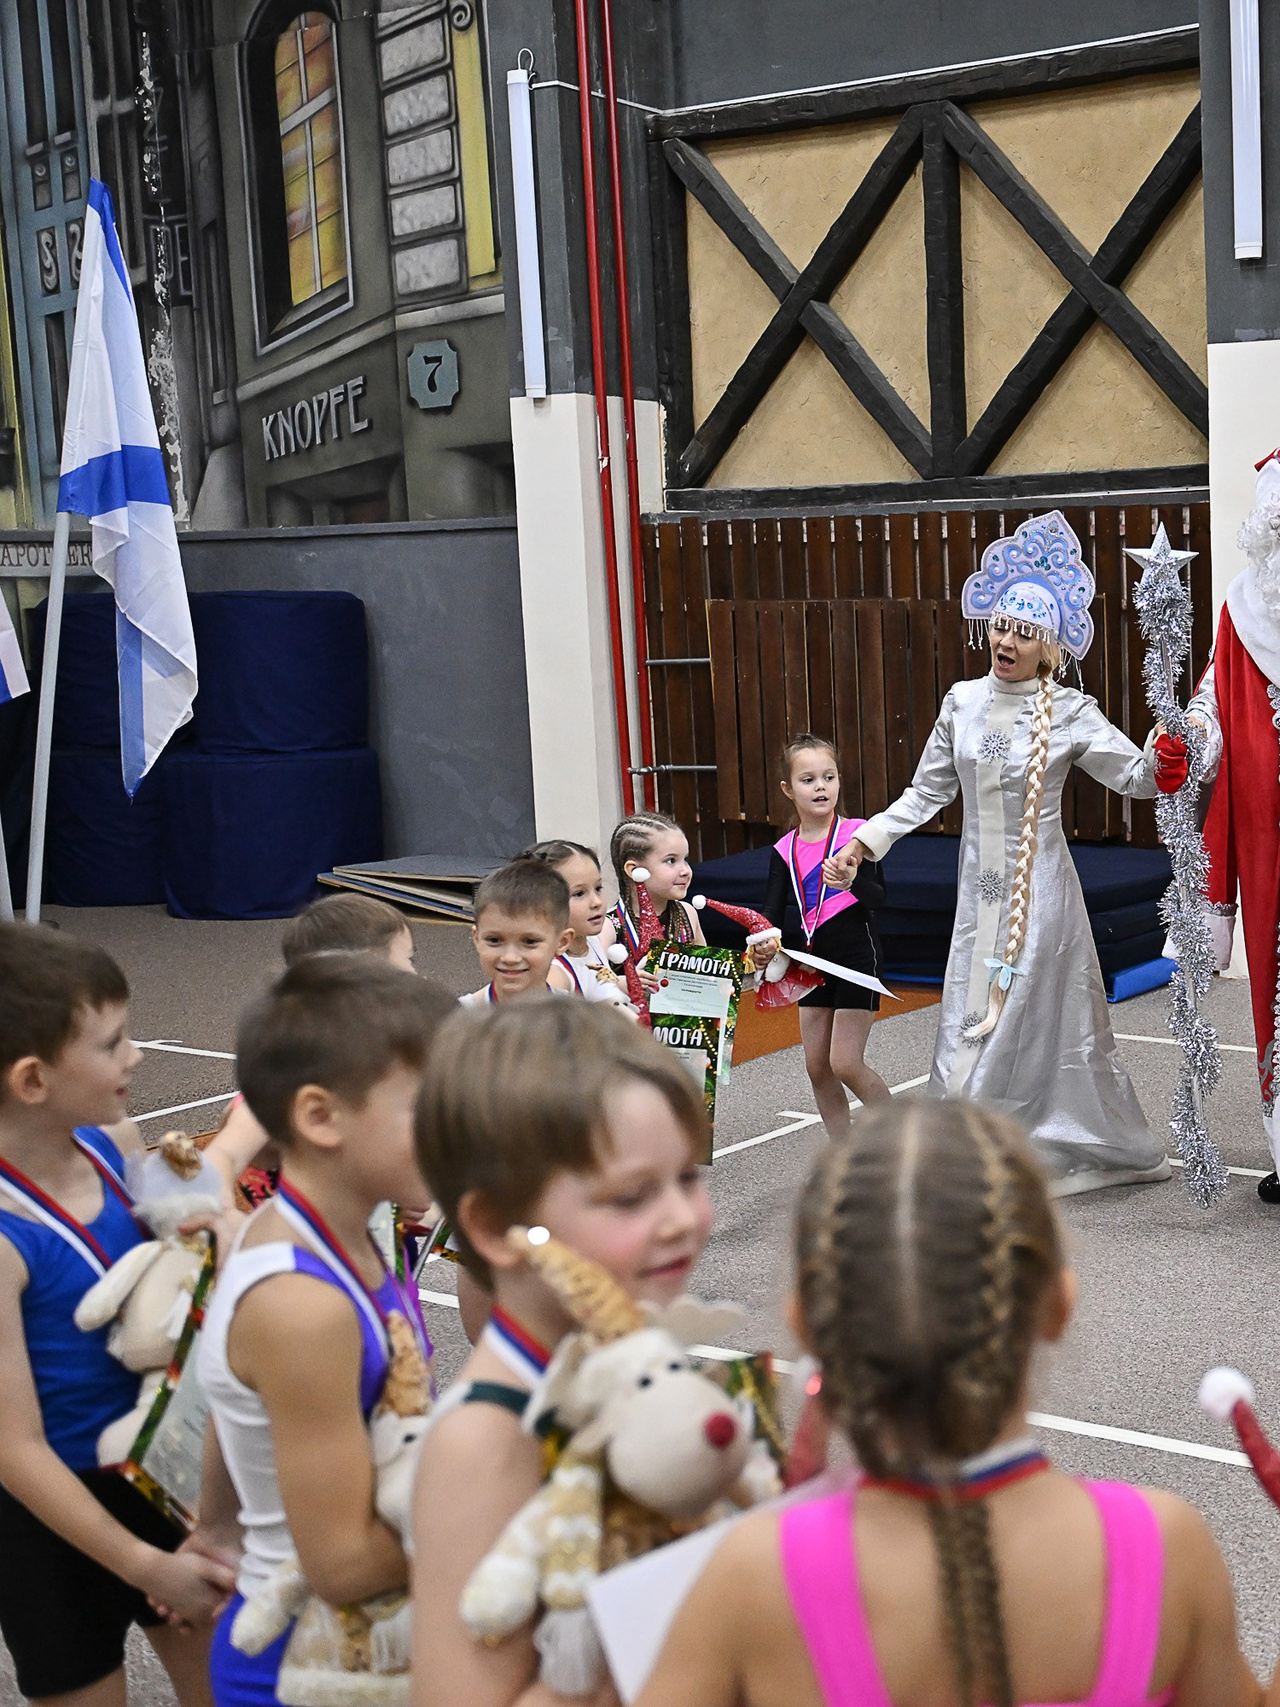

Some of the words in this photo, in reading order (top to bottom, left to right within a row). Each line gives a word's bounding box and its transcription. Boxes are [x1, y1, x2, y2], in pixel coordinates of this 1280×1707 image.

[422, 355, 443, 393] 7
[261, 375, 369, 461] KNOPFE
[660, 951, 731, 976] ГРАМОТА
[653, 1026, 703, 1047] МОТА
